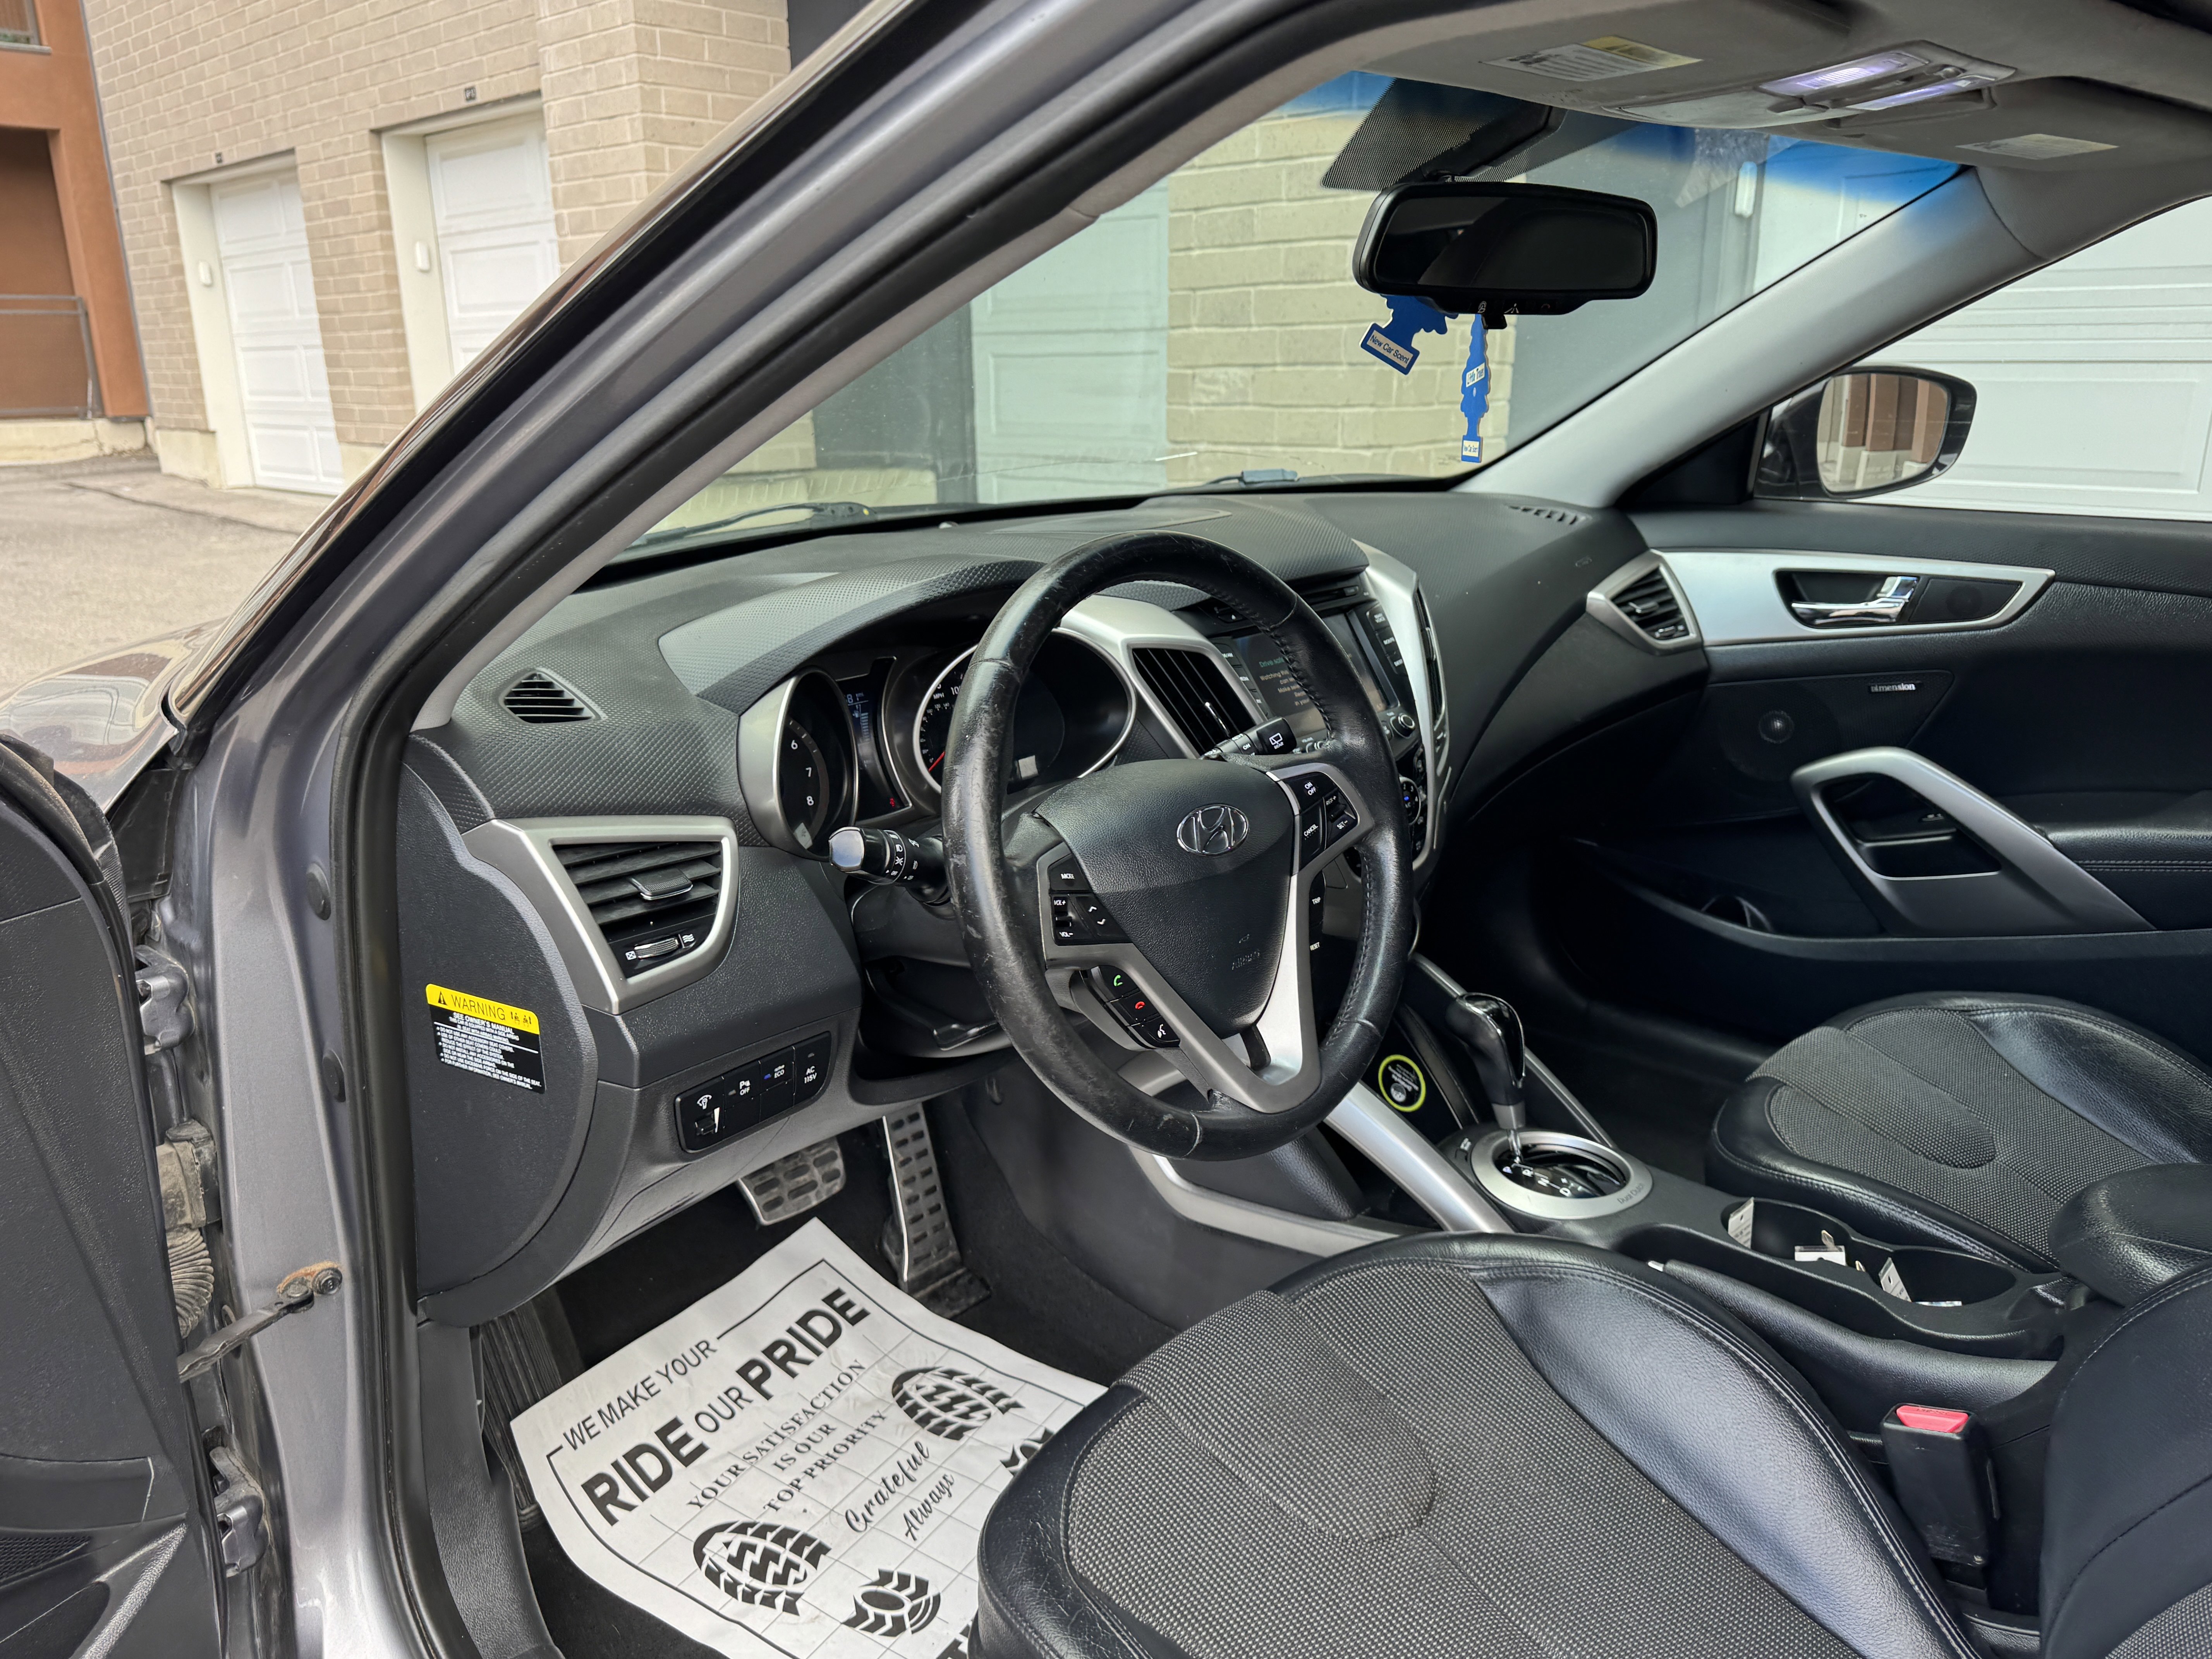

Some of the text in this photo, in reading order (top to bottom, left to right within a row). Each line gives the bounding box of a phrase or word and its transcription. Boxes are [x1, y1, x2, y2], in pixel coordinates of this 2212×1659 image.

[1370, 335, 1410, 364] New Car Scent
[791, 740, 798, 749] 6
[806, 767, 812, 777] 7
[807, 796, 814, 805] 8
[1307, 787, 1317, 795] OFF
[1304, 824, 1318, 836] CANCEL
[451, 994, 505, 1020] WARNING
[453, 1012, 514, 1034] SEE OWNER'S MANUAL
[774, 1069, 785, 1079] ECO
[804, 1072, 817, 1084] 115V
[806, 1066, 815, 1075] AC
[740, 1087, 750, 1096] OFF
[1522, 1169, 1534, 1177] R
[1559, 1187, 1571, 1197] D
[563, 1339, 717, 1451] WE MAKE YOUR
[580, 1287, 871, 1526] RIDE OUR PRIDE
[686, 1358, 866, 1511] YOUR SATISFACTION
[772, 1422, 837, 1472] IS OUR
[763, 1410, 888, 1511] TOP PRIORITY
[844, 1440, 931, 1534] Grateful
[902, 1471, 955, 1542] Always
